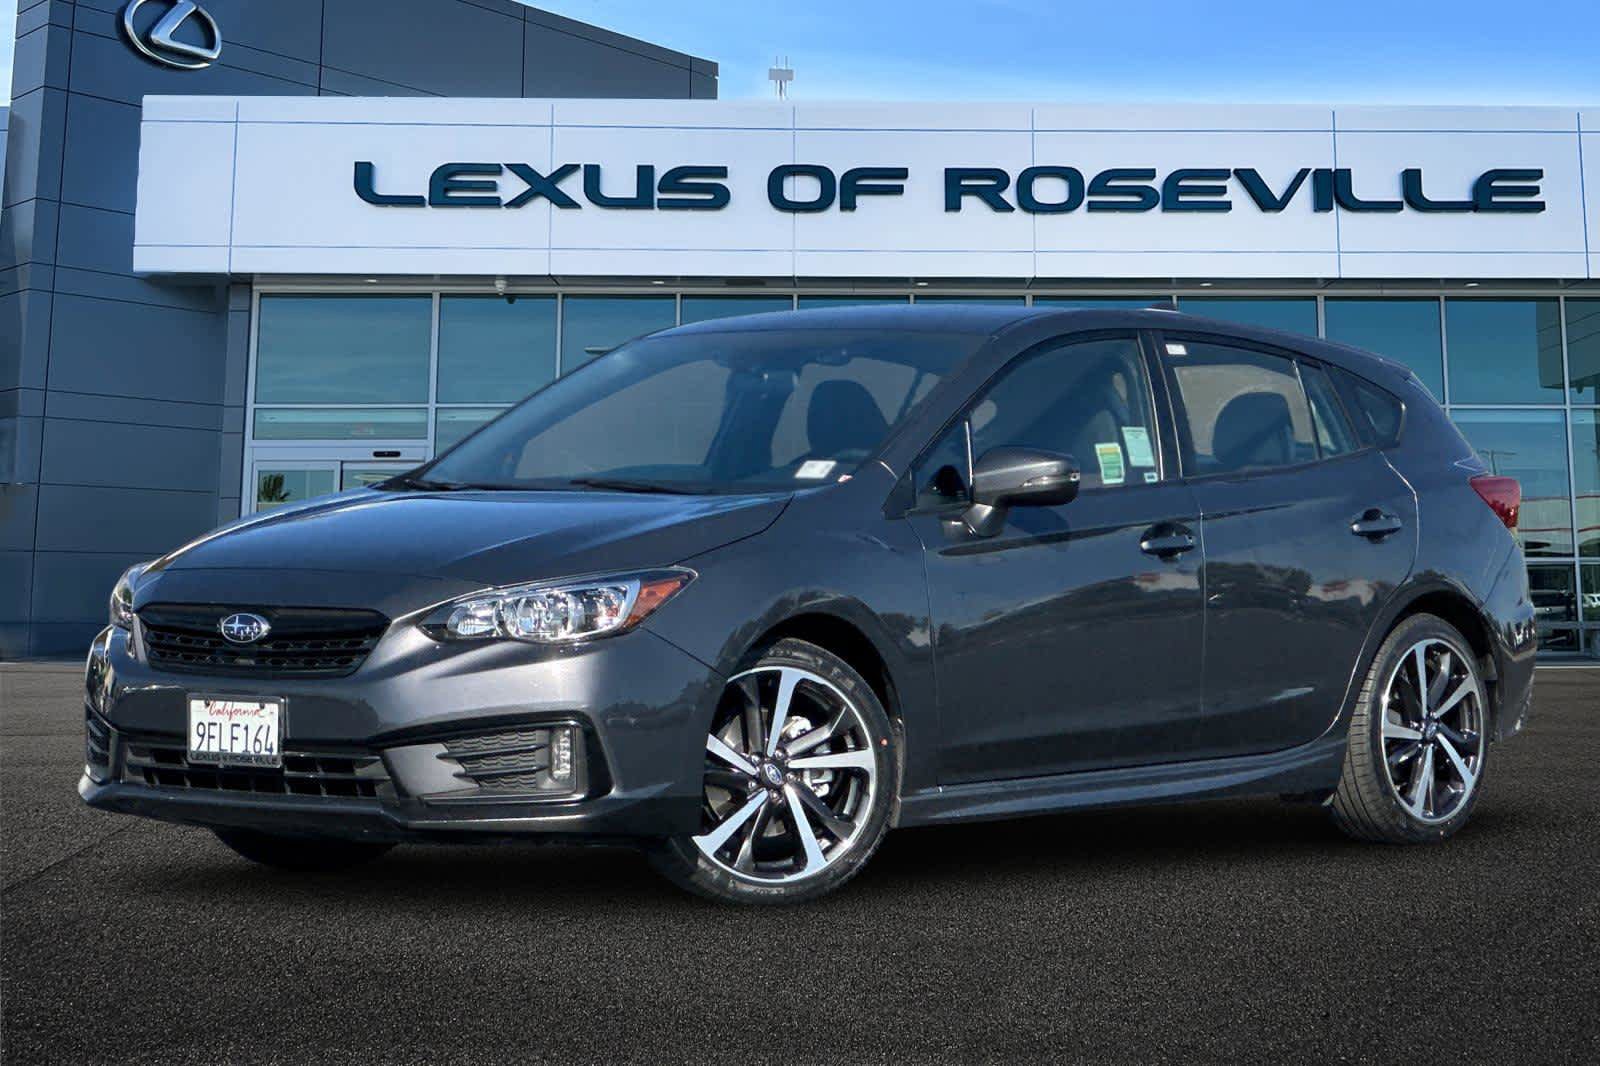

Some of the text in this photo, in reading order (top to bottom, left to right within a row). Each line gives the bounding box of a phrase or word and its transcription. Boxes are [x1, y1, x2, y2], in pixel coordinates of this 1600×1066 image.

[354, 161, 1546, 215] LEXUS OF ROSEVILLE
[209, 699, 263, 720] California
[196, 721, 273, 755] 9FLF164
